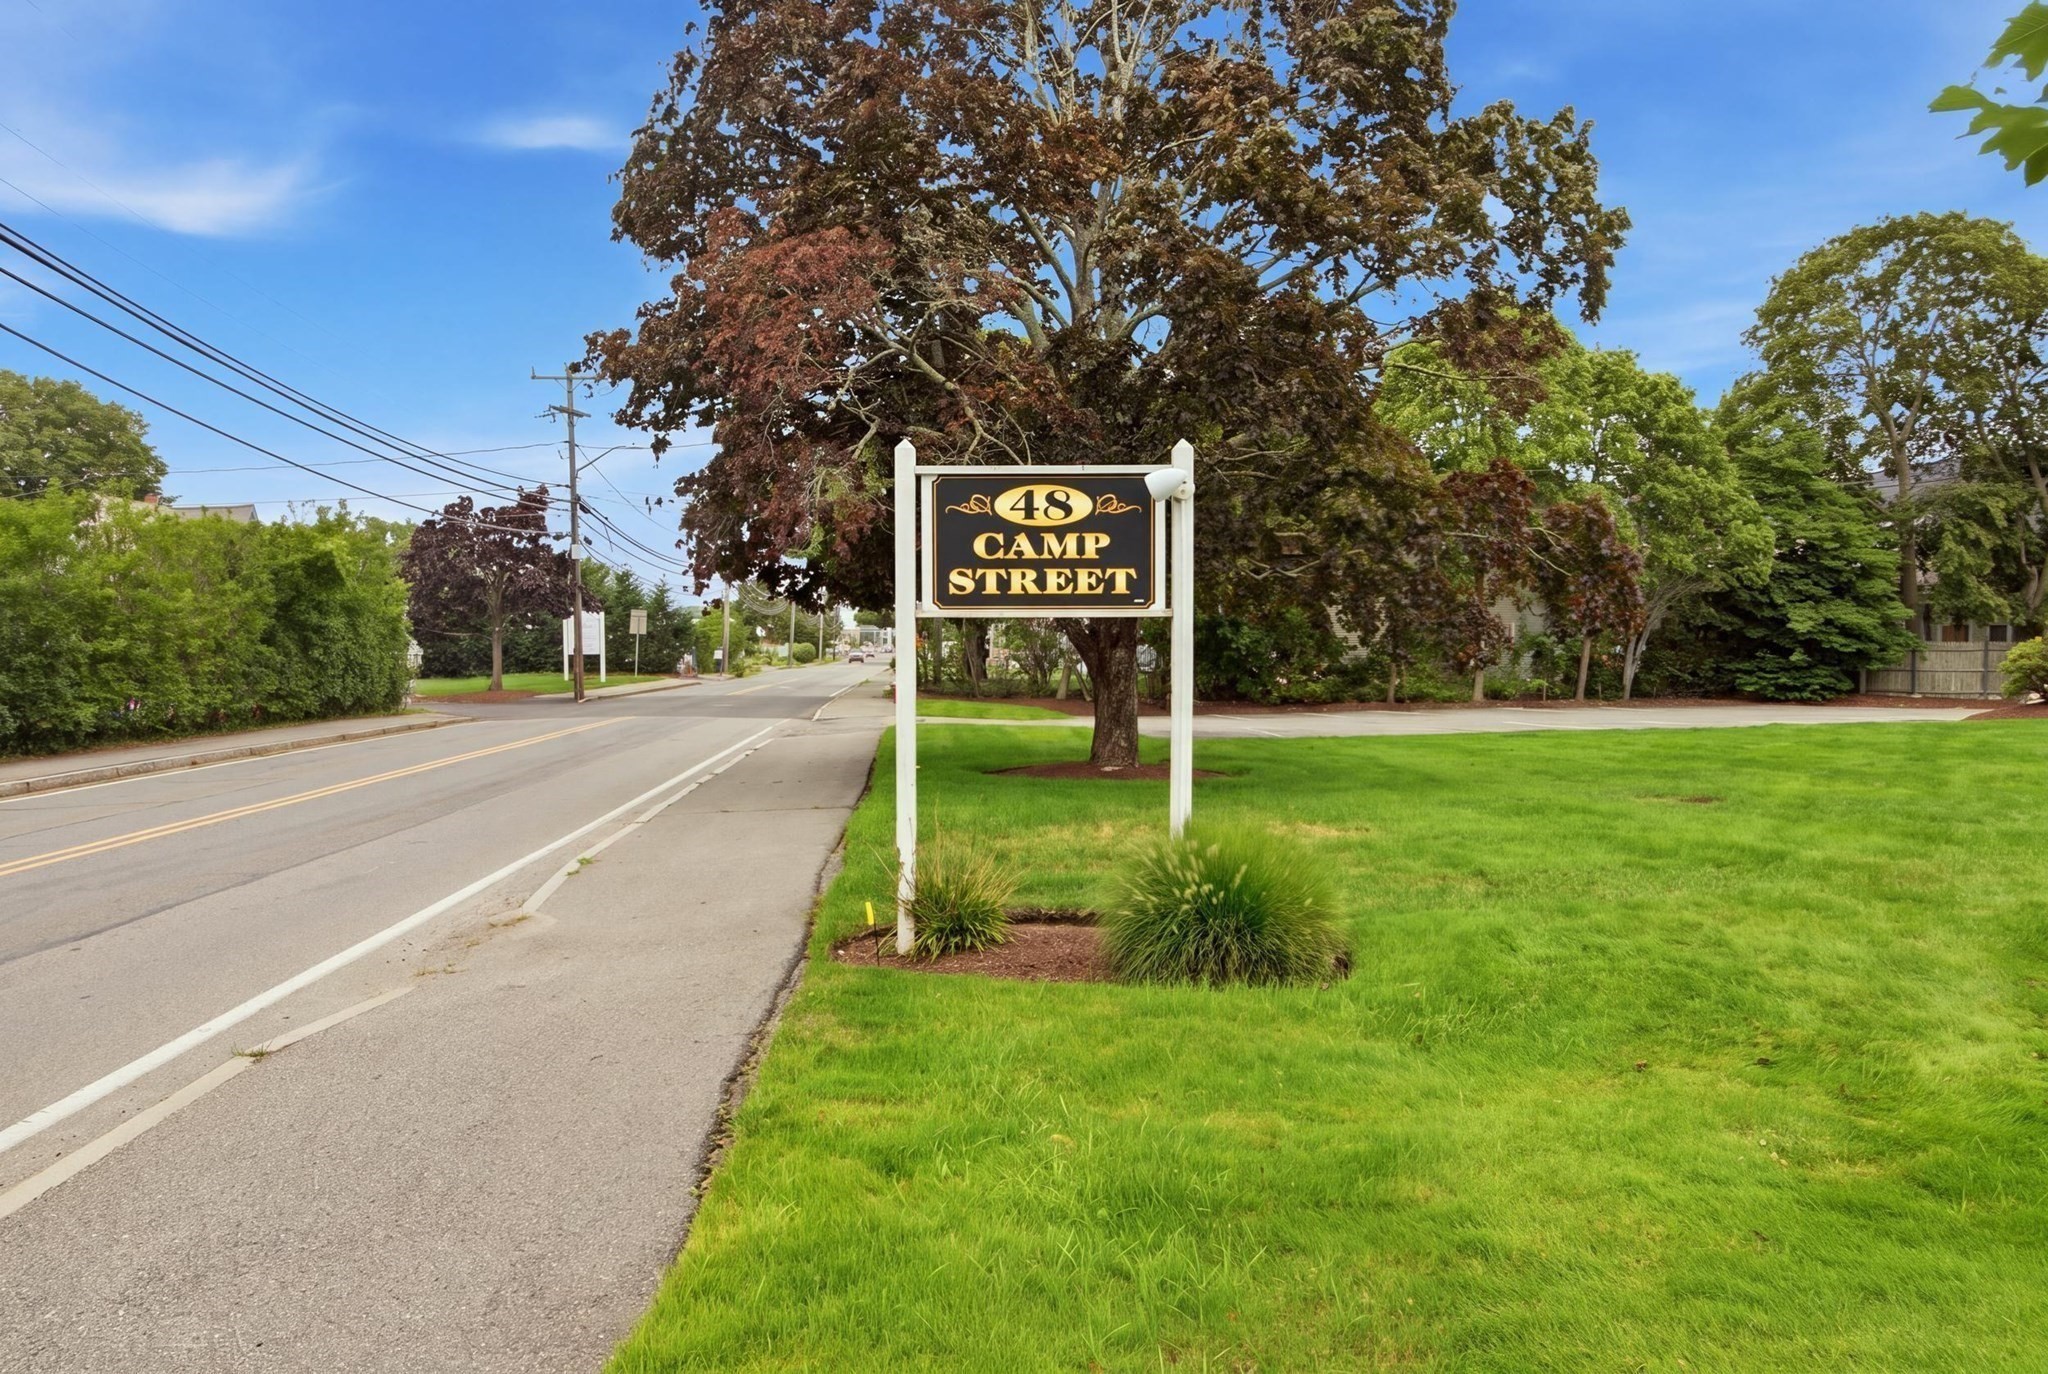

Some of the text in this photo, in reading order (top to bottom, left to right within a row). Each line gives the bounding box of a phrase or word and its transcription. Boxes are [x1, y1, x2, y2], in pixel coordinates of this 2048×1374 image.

[1009, 489, 1073, 520] 48
[973, 532, 1110, 559] CAMP
[949, 568, 1137, 594] STREET
